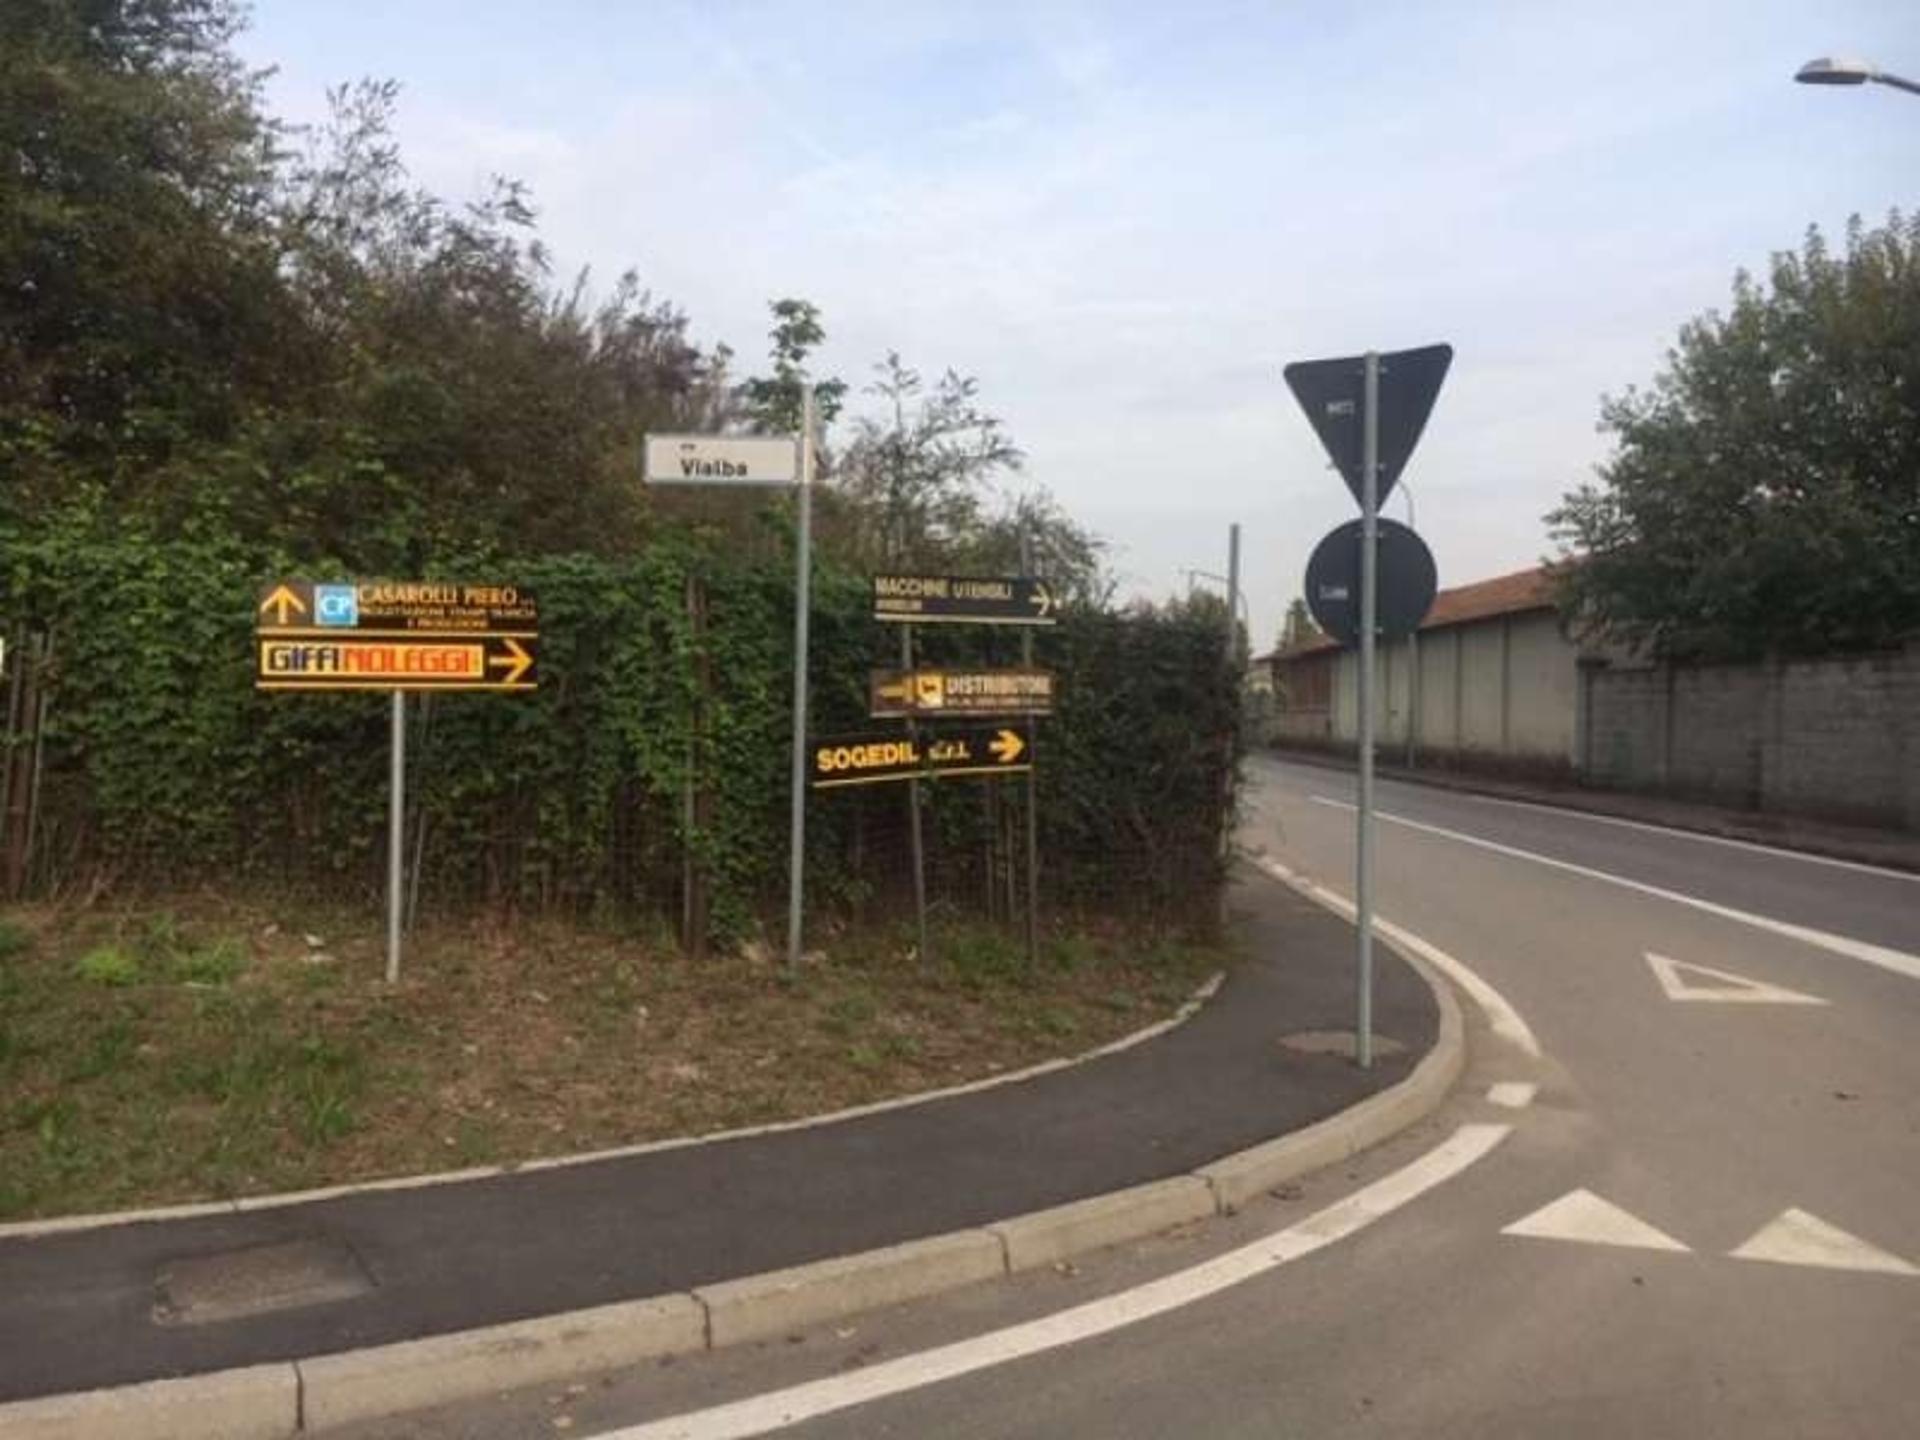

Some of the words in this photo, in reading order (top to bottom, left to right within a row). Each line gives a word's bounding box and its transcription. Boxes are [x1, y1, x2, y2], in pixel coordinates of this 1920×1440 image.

[680, 459, 748, 477] Vialba
[359, 584, 457, 605] CASAROLLI
[875, 576, 949, 597] MACCHINE
[816, 741, 920, 772] SOGEDIL
